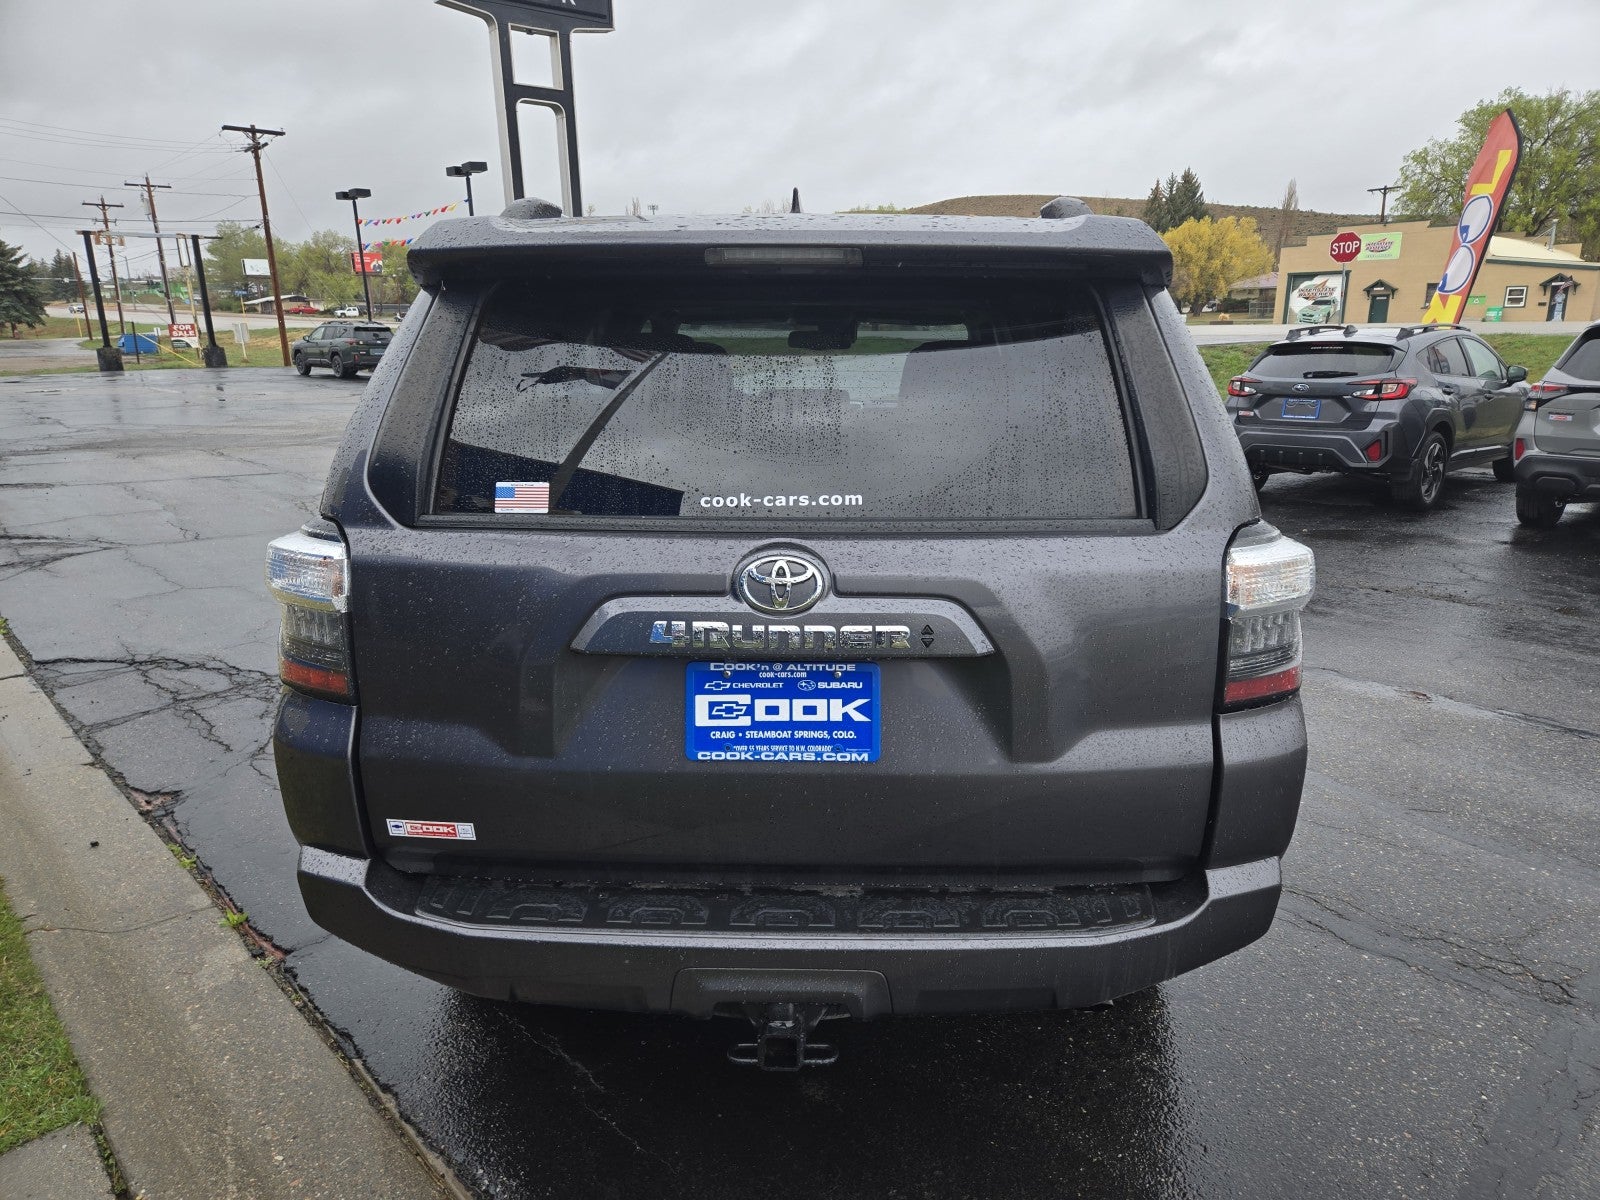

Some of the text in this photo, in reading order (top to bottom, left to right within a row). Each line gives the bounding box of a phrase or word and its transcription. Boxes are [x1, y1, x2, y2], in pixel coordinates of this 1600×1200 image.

[1332, 241, 1359, 254] STOP
[700, 493, 863, 508] cook-cars.com
[786, 663, 856, 672] ALTITUDE
[817, 681, 863, 689] SUBARU
[694, 694, 872, 727] COOK
[710, 730, 857, 740] CRAIG STEAMBOAT SPRINGS, COLO.
[697, 752, 869, 761] COOK-CARS.COM
[405, 823, 455, 833] COOK
